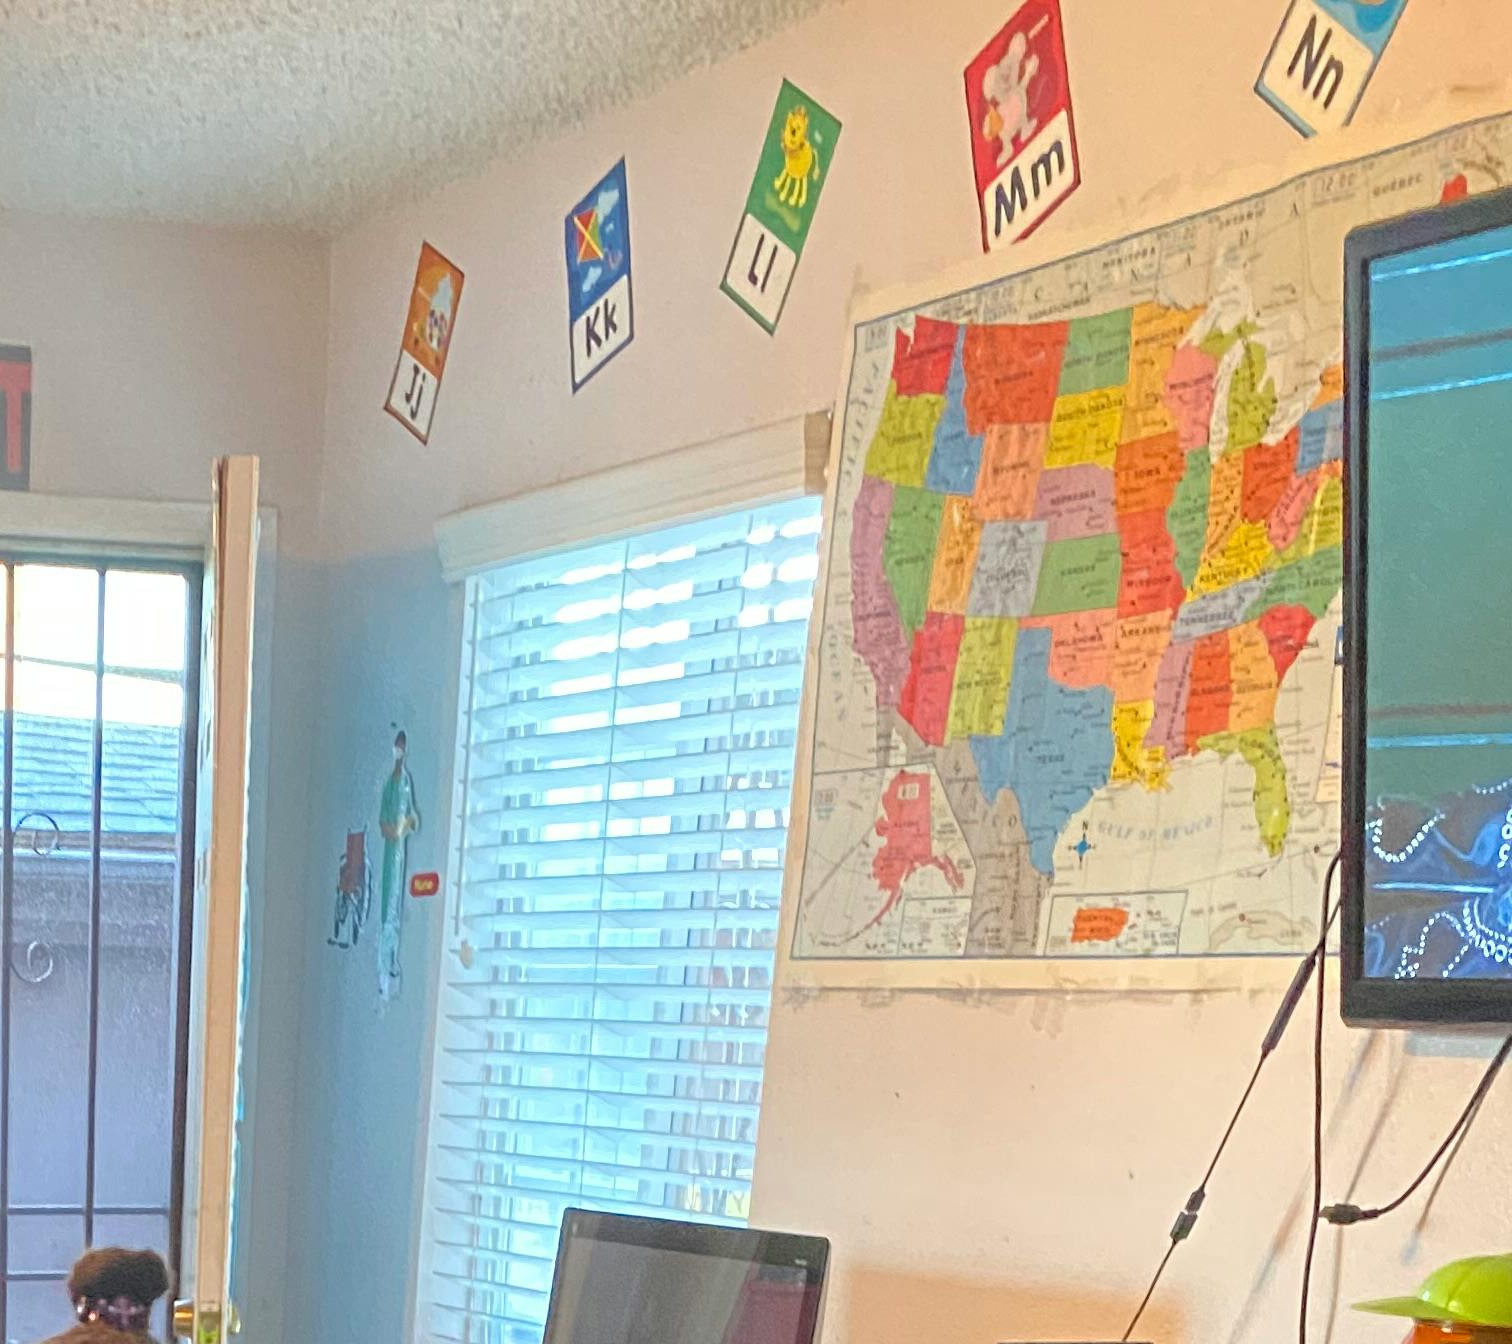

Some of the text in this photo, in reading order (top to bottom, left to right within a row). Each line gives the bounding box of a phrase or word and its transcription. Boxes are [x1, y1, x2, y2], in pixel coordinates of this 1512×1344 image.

[1288, 13, 1345, 111] Nn
[991, 137, 1066, 238] Mm
[747, 232, 779, 294] Ll
[585, 298, 619, 358] Kk
[404, 363, 427, 419] Jj
